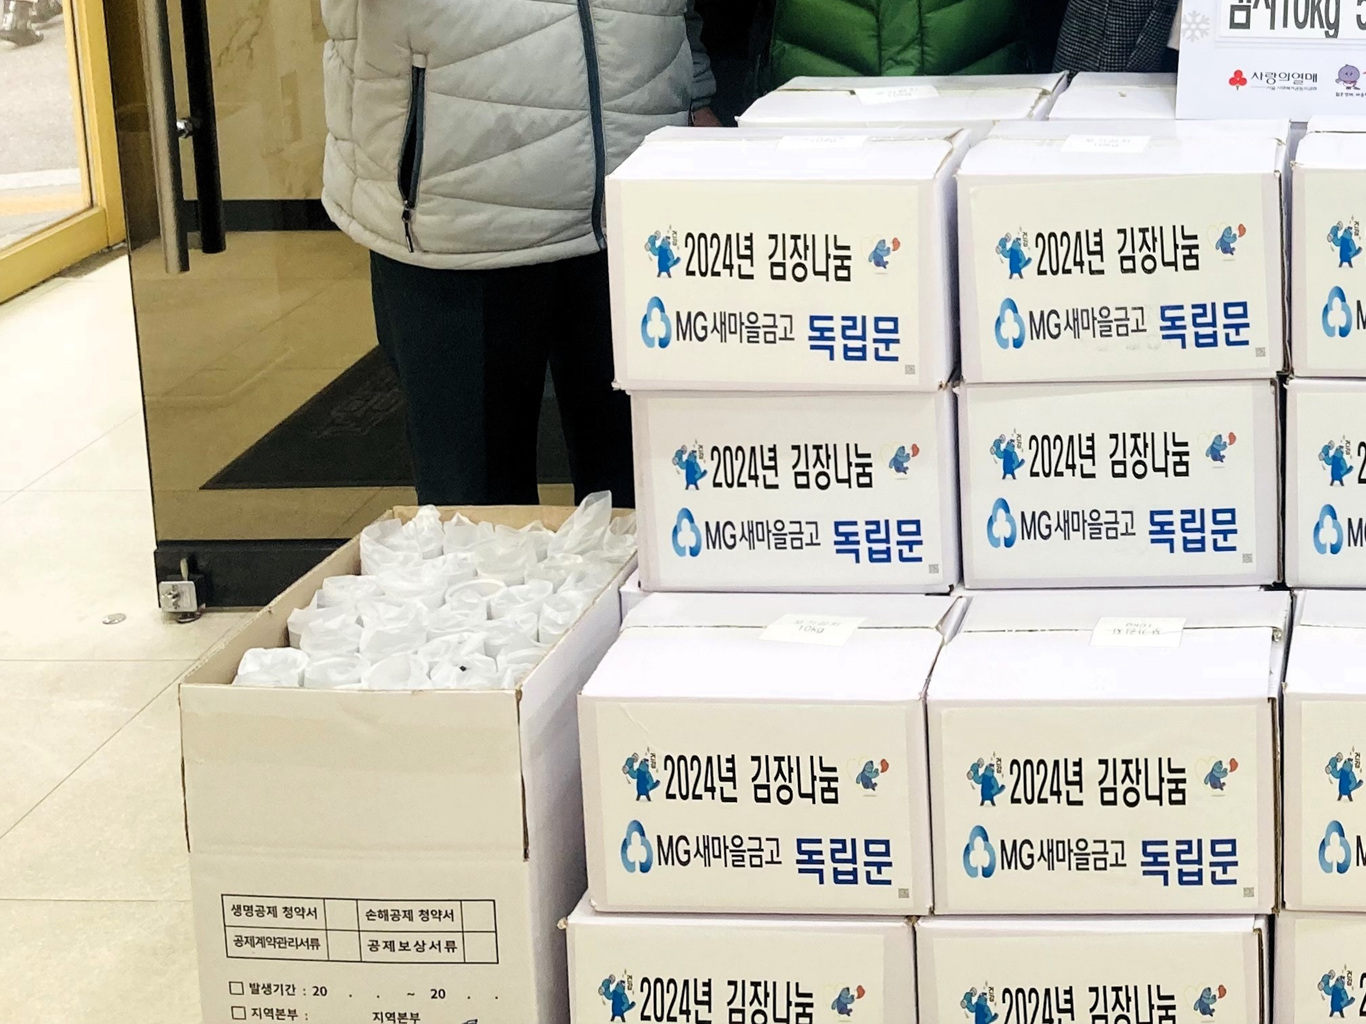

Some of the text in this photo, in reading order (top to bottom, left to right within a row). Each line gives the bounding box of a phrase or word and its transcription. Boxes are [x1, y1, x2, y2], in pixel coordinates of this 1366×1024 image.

[1251, 71, 1318, 85] 사랑의열매
[685, 232, 852, 282] 2024년 김장나눔
[1034, 225, 1199, 276] 2024년 김장나눔
[808, 315, 900, 361] 독립문
[1160, 301, 1250, 349] 독립문
[710, 443, 873, 490] 2024년 김장나눔
[1029, 432, 1189, 479] 2024년 김장나눔
[834, 519, 923, 563] 독립문
[1149, 508, 1237, 553] 독립문
[664, 754, 838, 805] 2024년 김장나눔
[1010, 757, 1186, 808] 2024년 김장나눔
[796, 838, 892, 885] 독립문
[1141, 839, 1238, 886] 독립문
[231, 904, 318, 920] 생명공제 청약서
[365, 909, 455, 922] 손해공제 청약서
[233, 935, 321, 950] 공제계약관리서류
[249, 982, 446, 1000] 발생기간 20 20
[640, 977, 814, 1024] 2024년 김장나눔
[1001, 984, 1176, 1024] 2024년 김장나눔
[251, 1007, 421, 1023] 지역본부 지역본부
